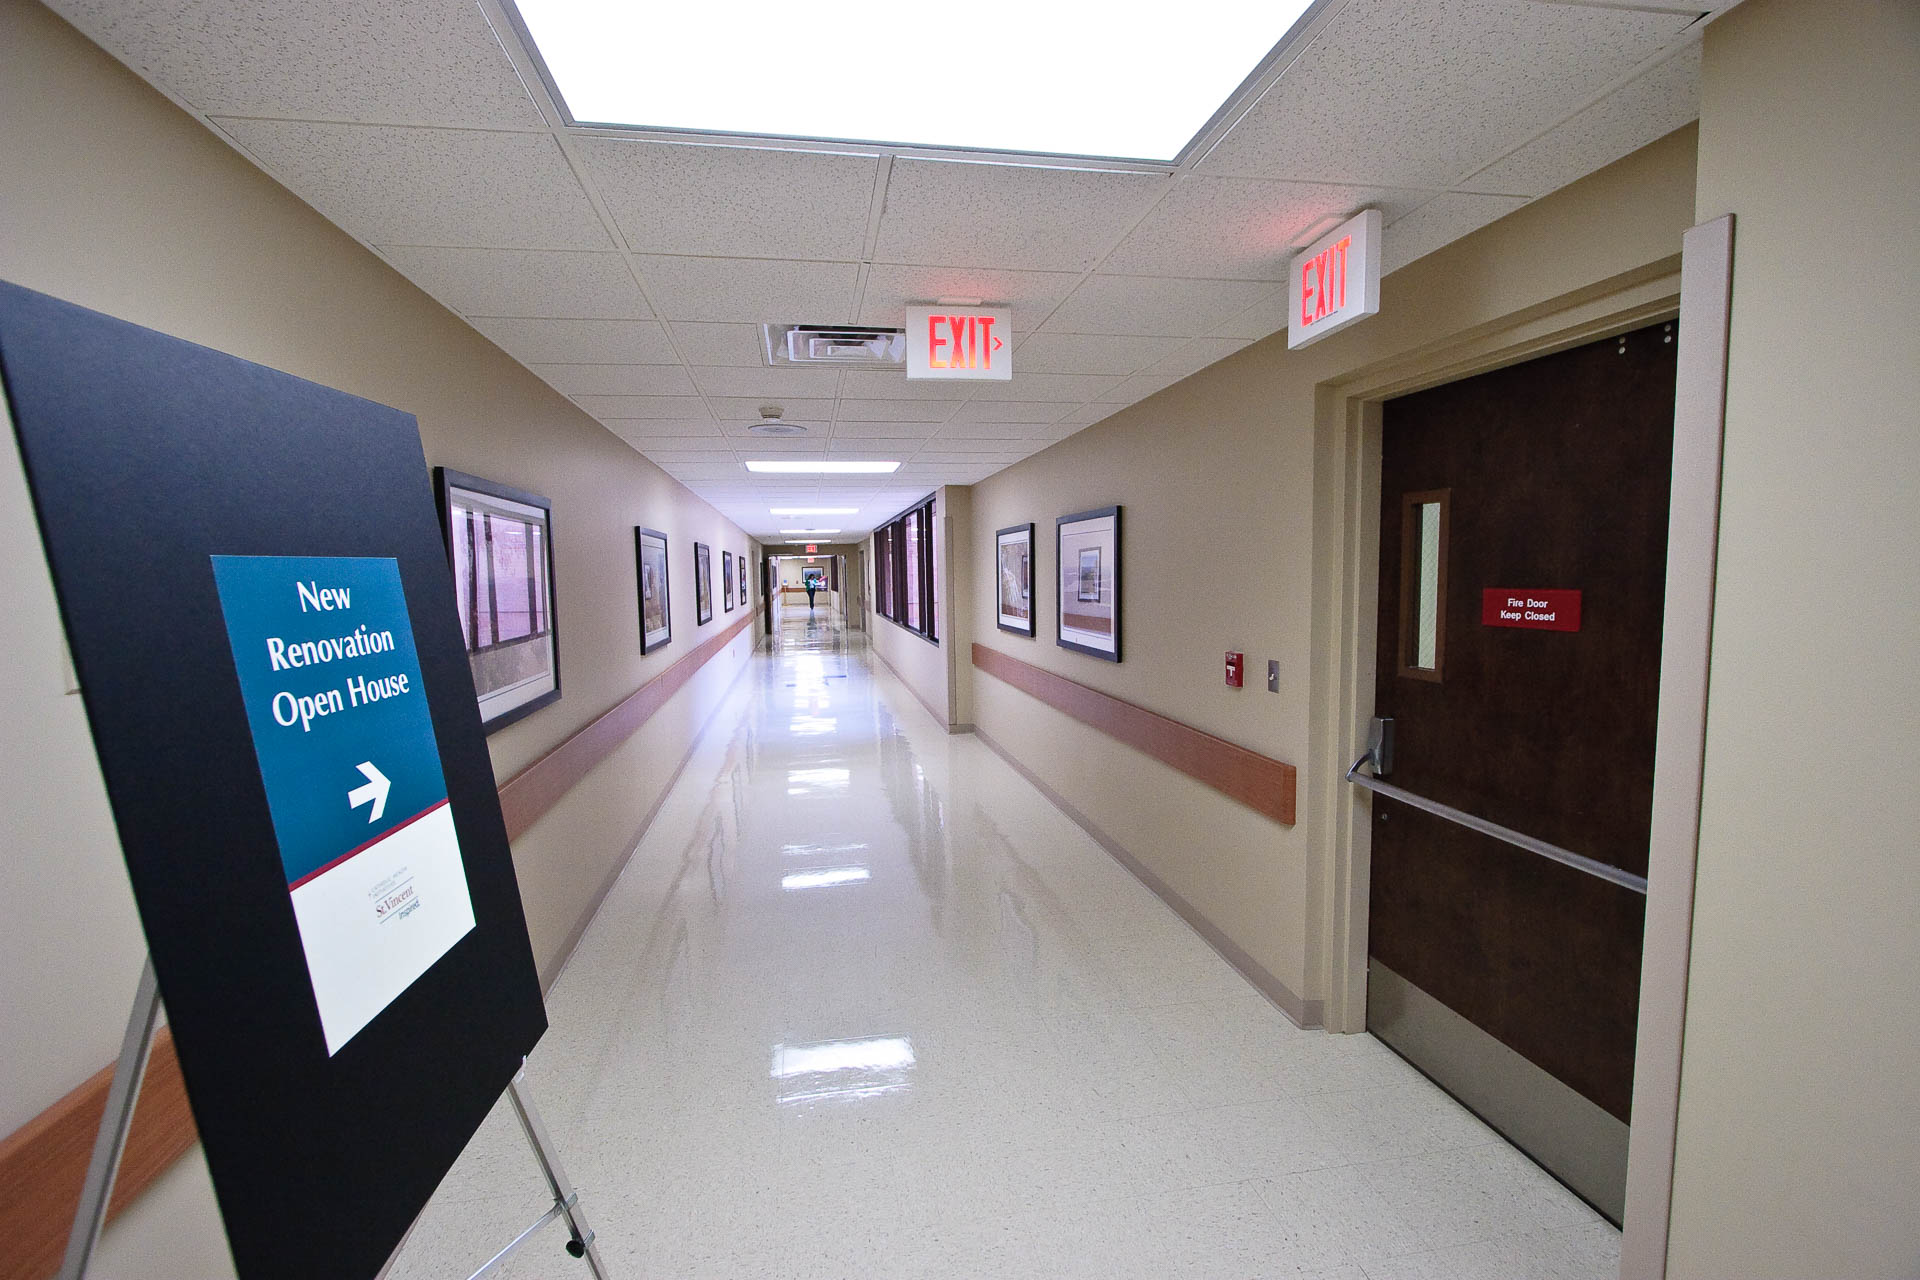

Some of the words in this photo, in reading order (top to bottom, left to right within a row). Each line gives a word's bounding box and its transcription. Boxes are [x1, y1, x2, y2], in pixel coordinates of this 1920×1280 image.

[1301, 234, 1352, 328] EXIT
[928, 315, 996, 370] EXIT
[296, 580, 351, 613] New
[1500, 610, 1522, 621] Keep
[1524, 611, 1556, 621] Closed
[1507, 598, 1524, 607] Fire
[1526, 598, 1549, 608] Door
[266, 624, 396, 672] Renovation
[272, 690, 345, 733] Open
[346, 673, 410, 708] House
